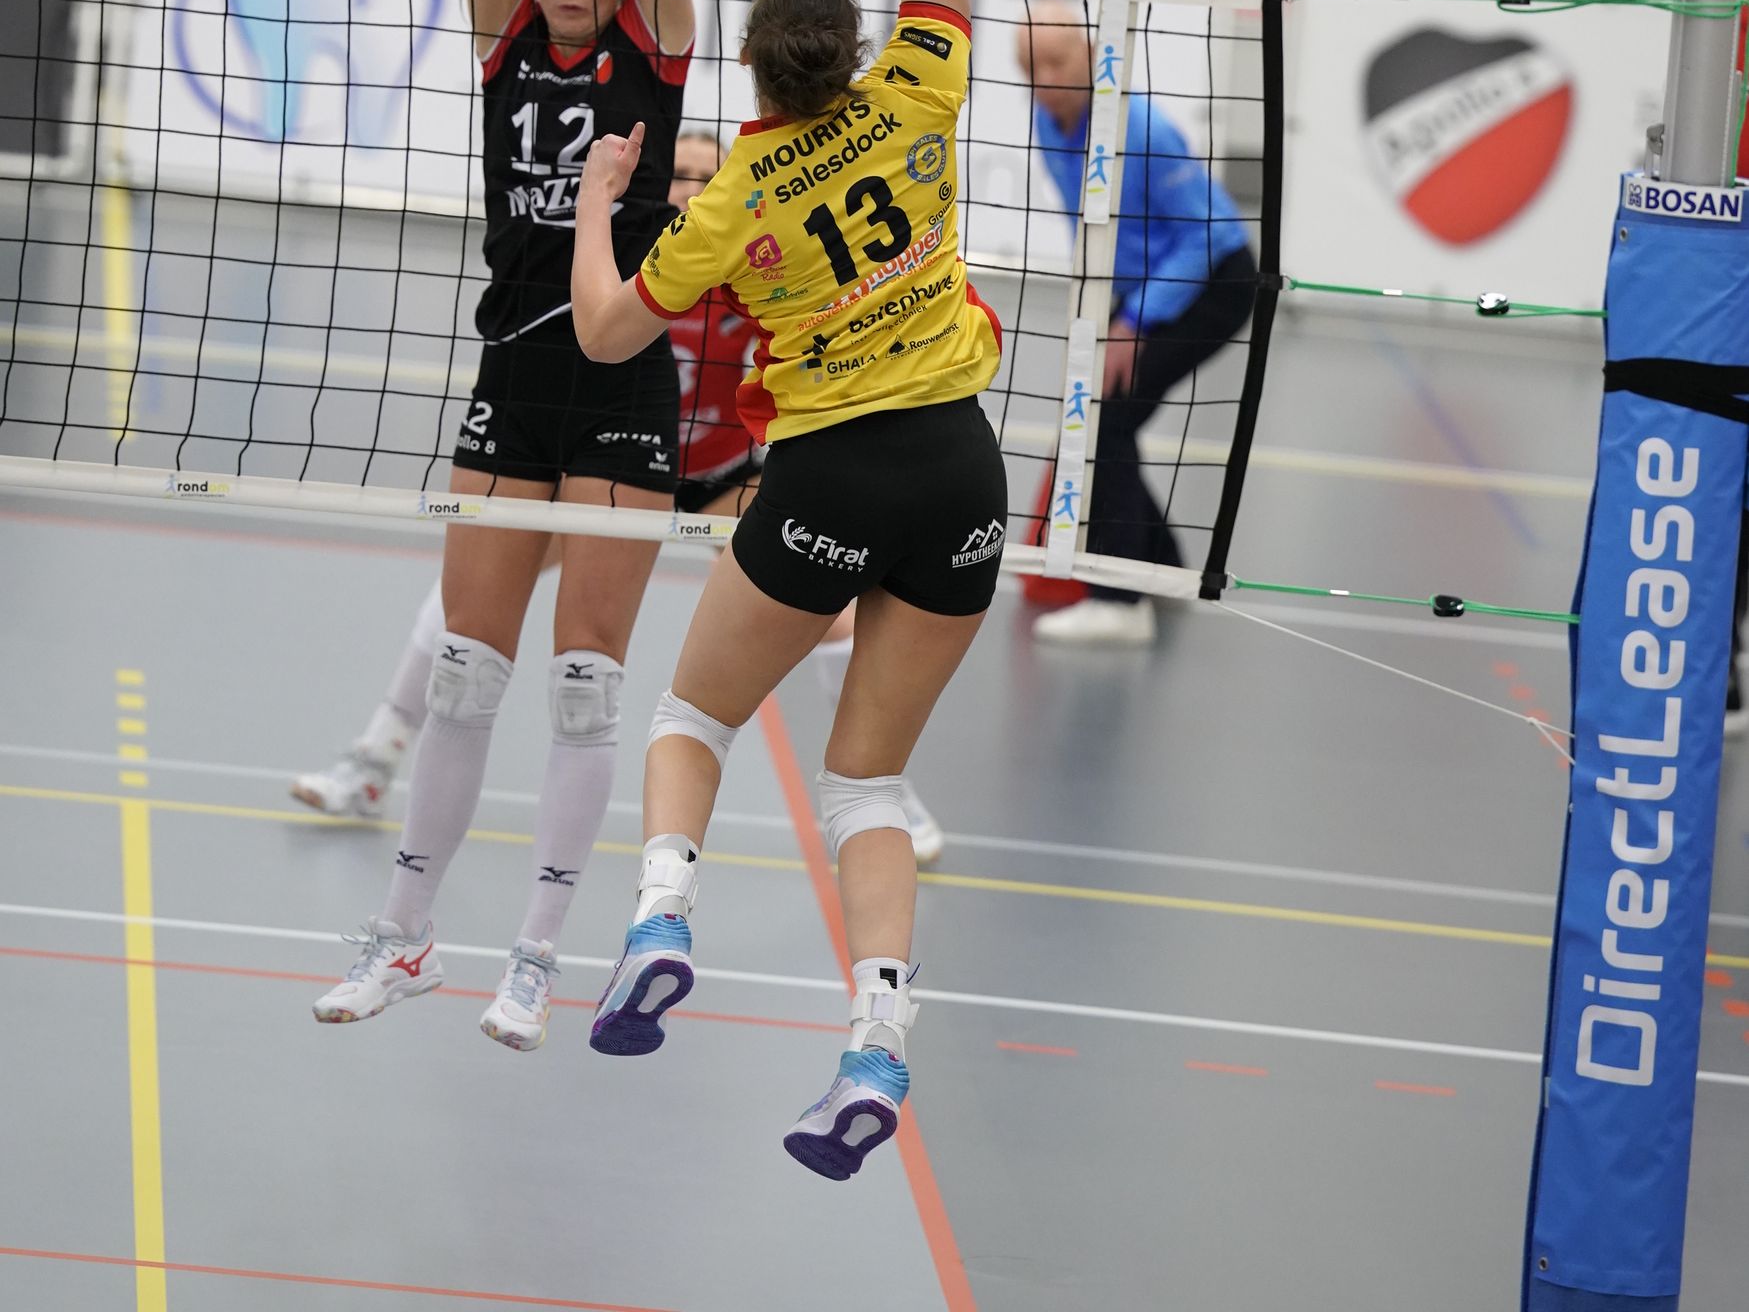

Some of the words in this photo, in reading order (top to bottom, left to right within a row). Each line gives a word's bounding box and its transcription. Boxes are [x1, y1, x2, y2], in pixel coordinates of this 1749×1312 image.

[511, 102, 594, 176] 12
[750, 97, 871, 182] MOURITS
[774, 112, 902, 204] salesdock
[1645, 186, 1739, 217] BOSAN
[803, 176, 913, 287] 13
[484, 439, 496, 455] 8
[177, 480, 230, 494] rondom
[429, 501, 481, 515] rondom
[680, 522, 733, 536] rondom
[808, 554, 864, 573] BAKERY
[1575, 436, 1700, 1086] DirectLease
